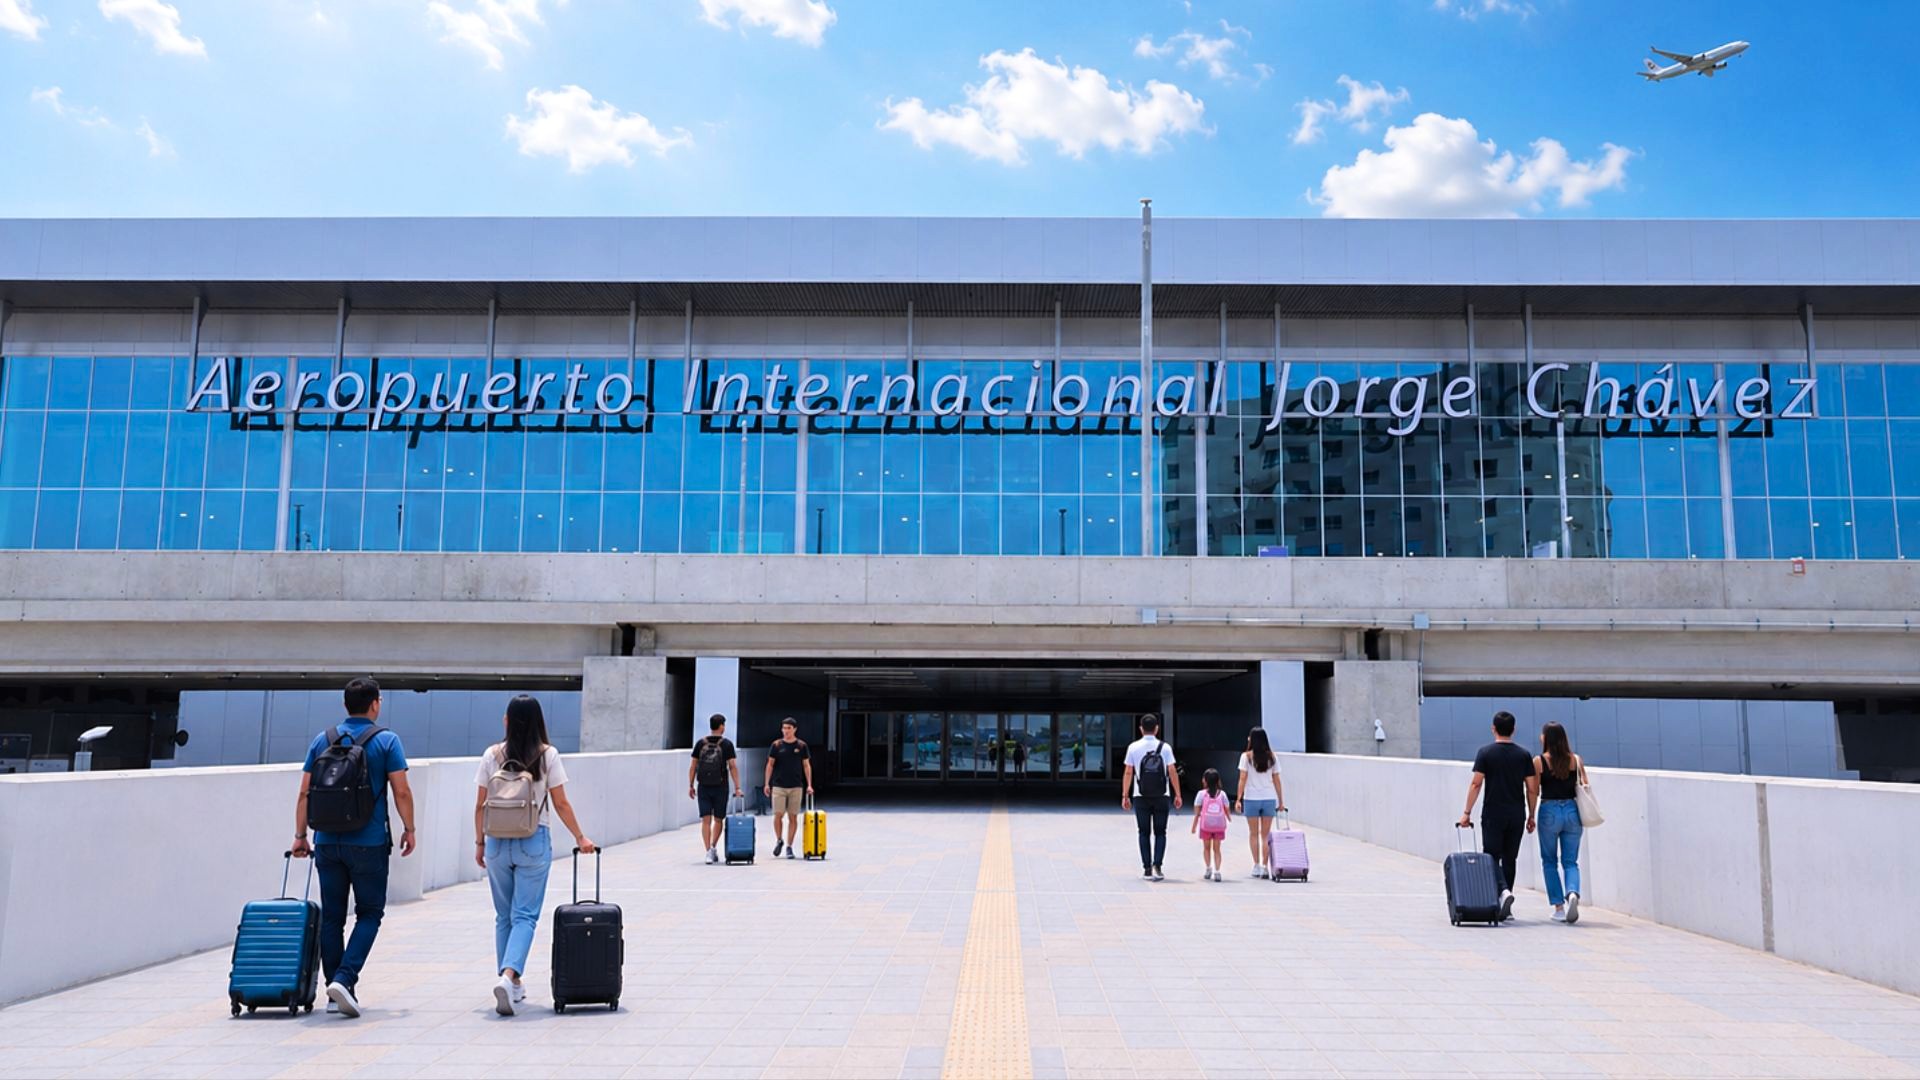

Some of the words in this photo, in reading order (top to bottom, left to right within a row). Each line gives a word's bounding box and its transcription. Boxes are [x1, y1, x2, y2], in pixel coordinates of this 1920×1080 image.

[186, 358, 633, 430] Aeropuerto
[682, 359, 1226, 415] Internacional
[1265, 362, 1477, 436] Jorge
[1526, 361, 1817, 419] Chávez
